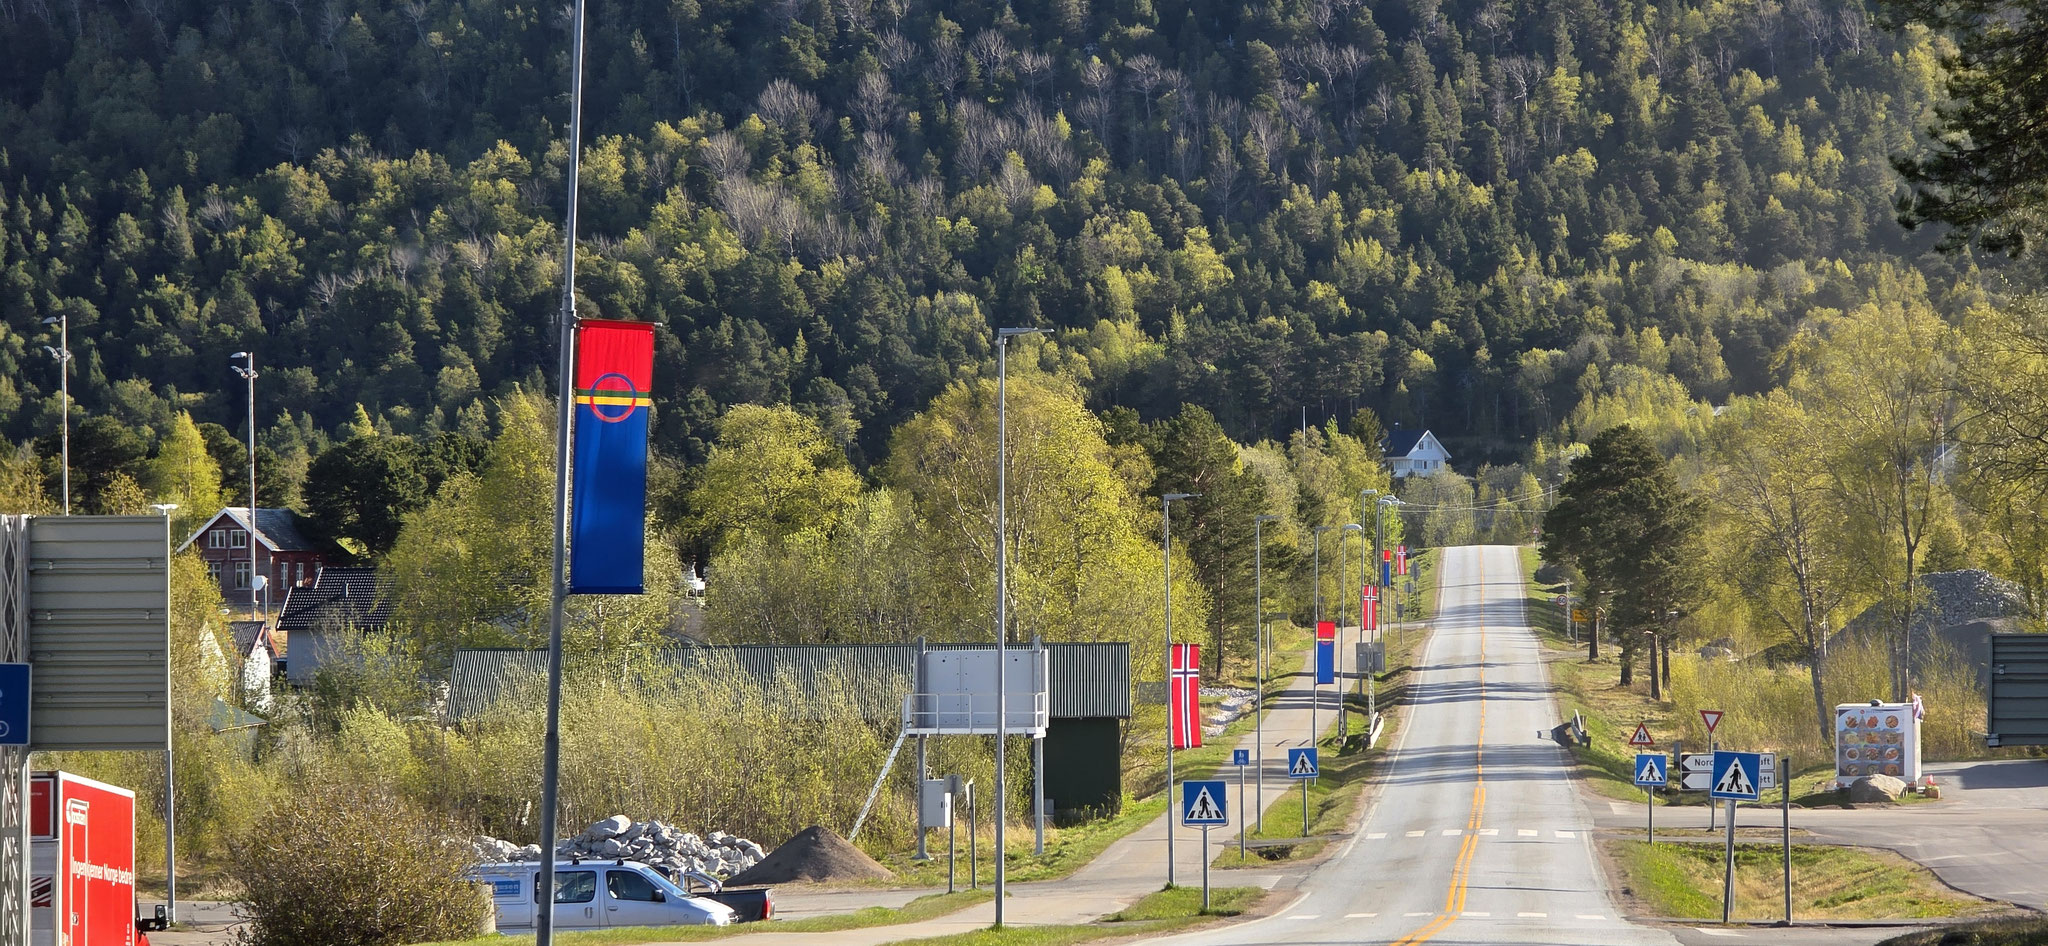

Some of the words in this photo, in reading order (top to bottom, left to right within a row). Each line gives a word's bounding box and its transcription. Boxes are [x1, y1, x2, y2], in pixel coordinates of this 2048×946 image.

[72, 857, 86, 879] Ingen
[103, 862, 118, 886] Norge
[118, 866, 132, 885] bedre
